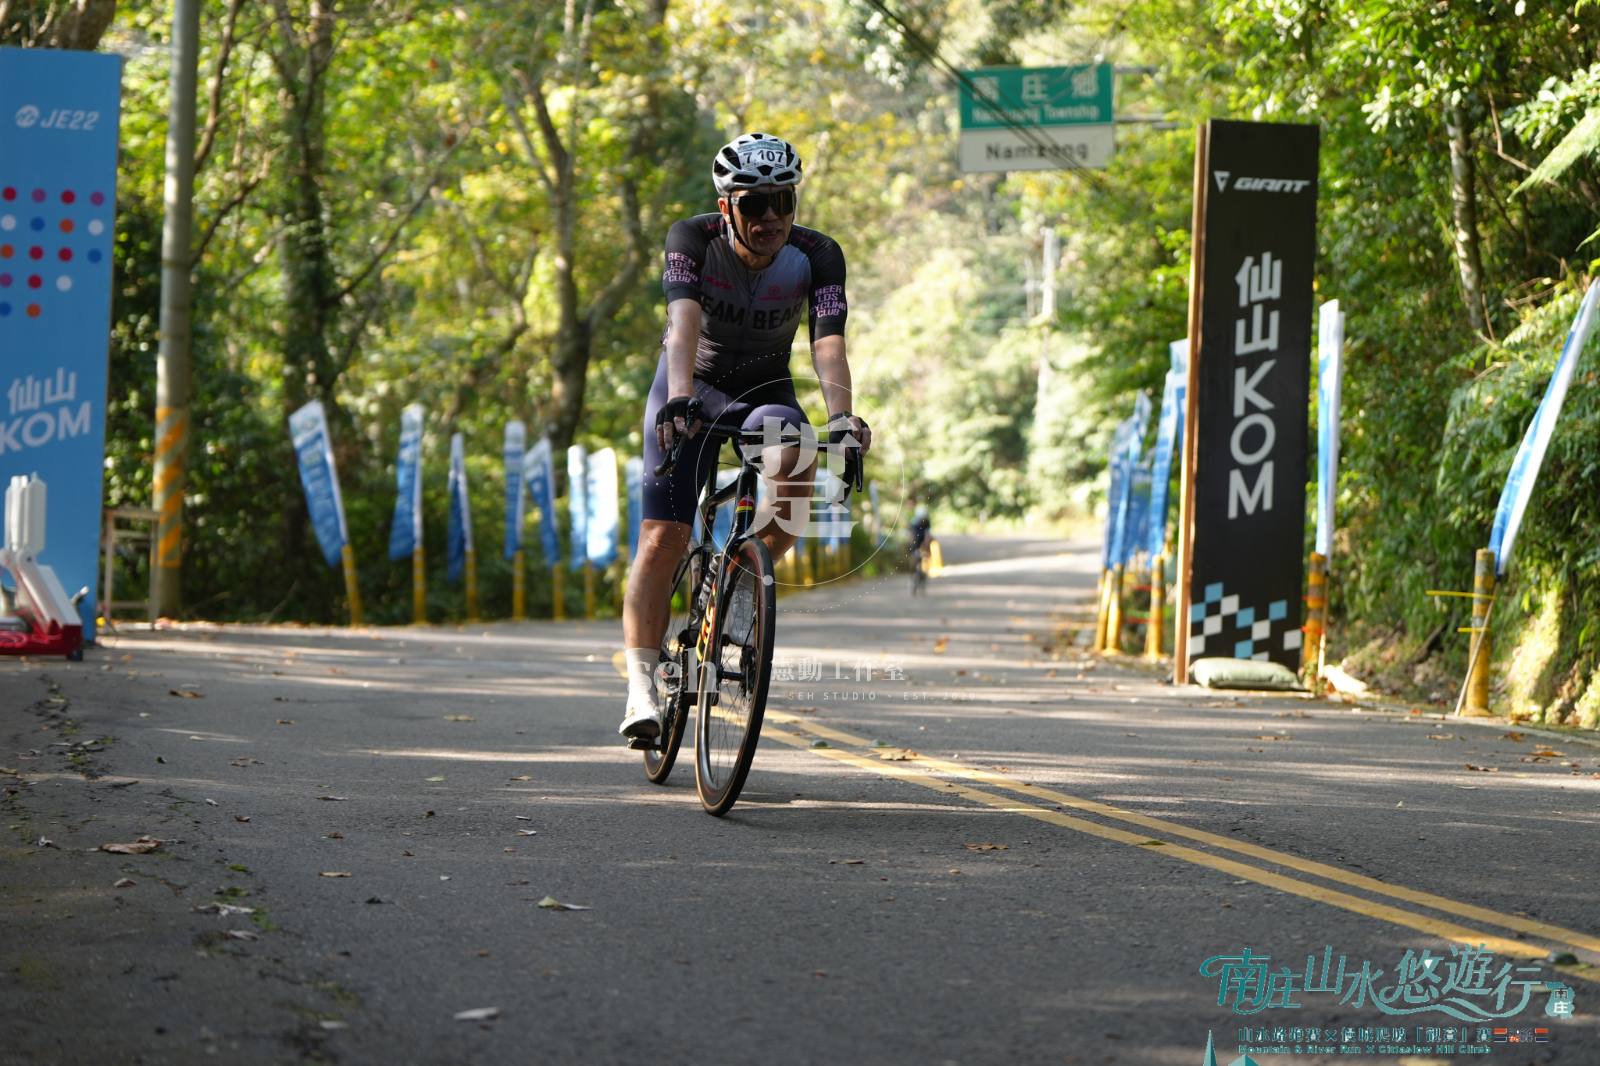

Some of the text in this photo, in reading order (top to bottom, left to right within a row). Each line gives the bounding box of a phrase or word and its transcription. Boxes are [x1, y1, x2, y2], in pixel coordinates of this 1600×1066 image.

[41, 109, 99, 130] JE22
[1233, 176, 1310, 193] GIANT
[701, 291, 746, 326] EAM
[8, 367, 77, 416] 仙山
[0, 401, 91, 455] KOM
